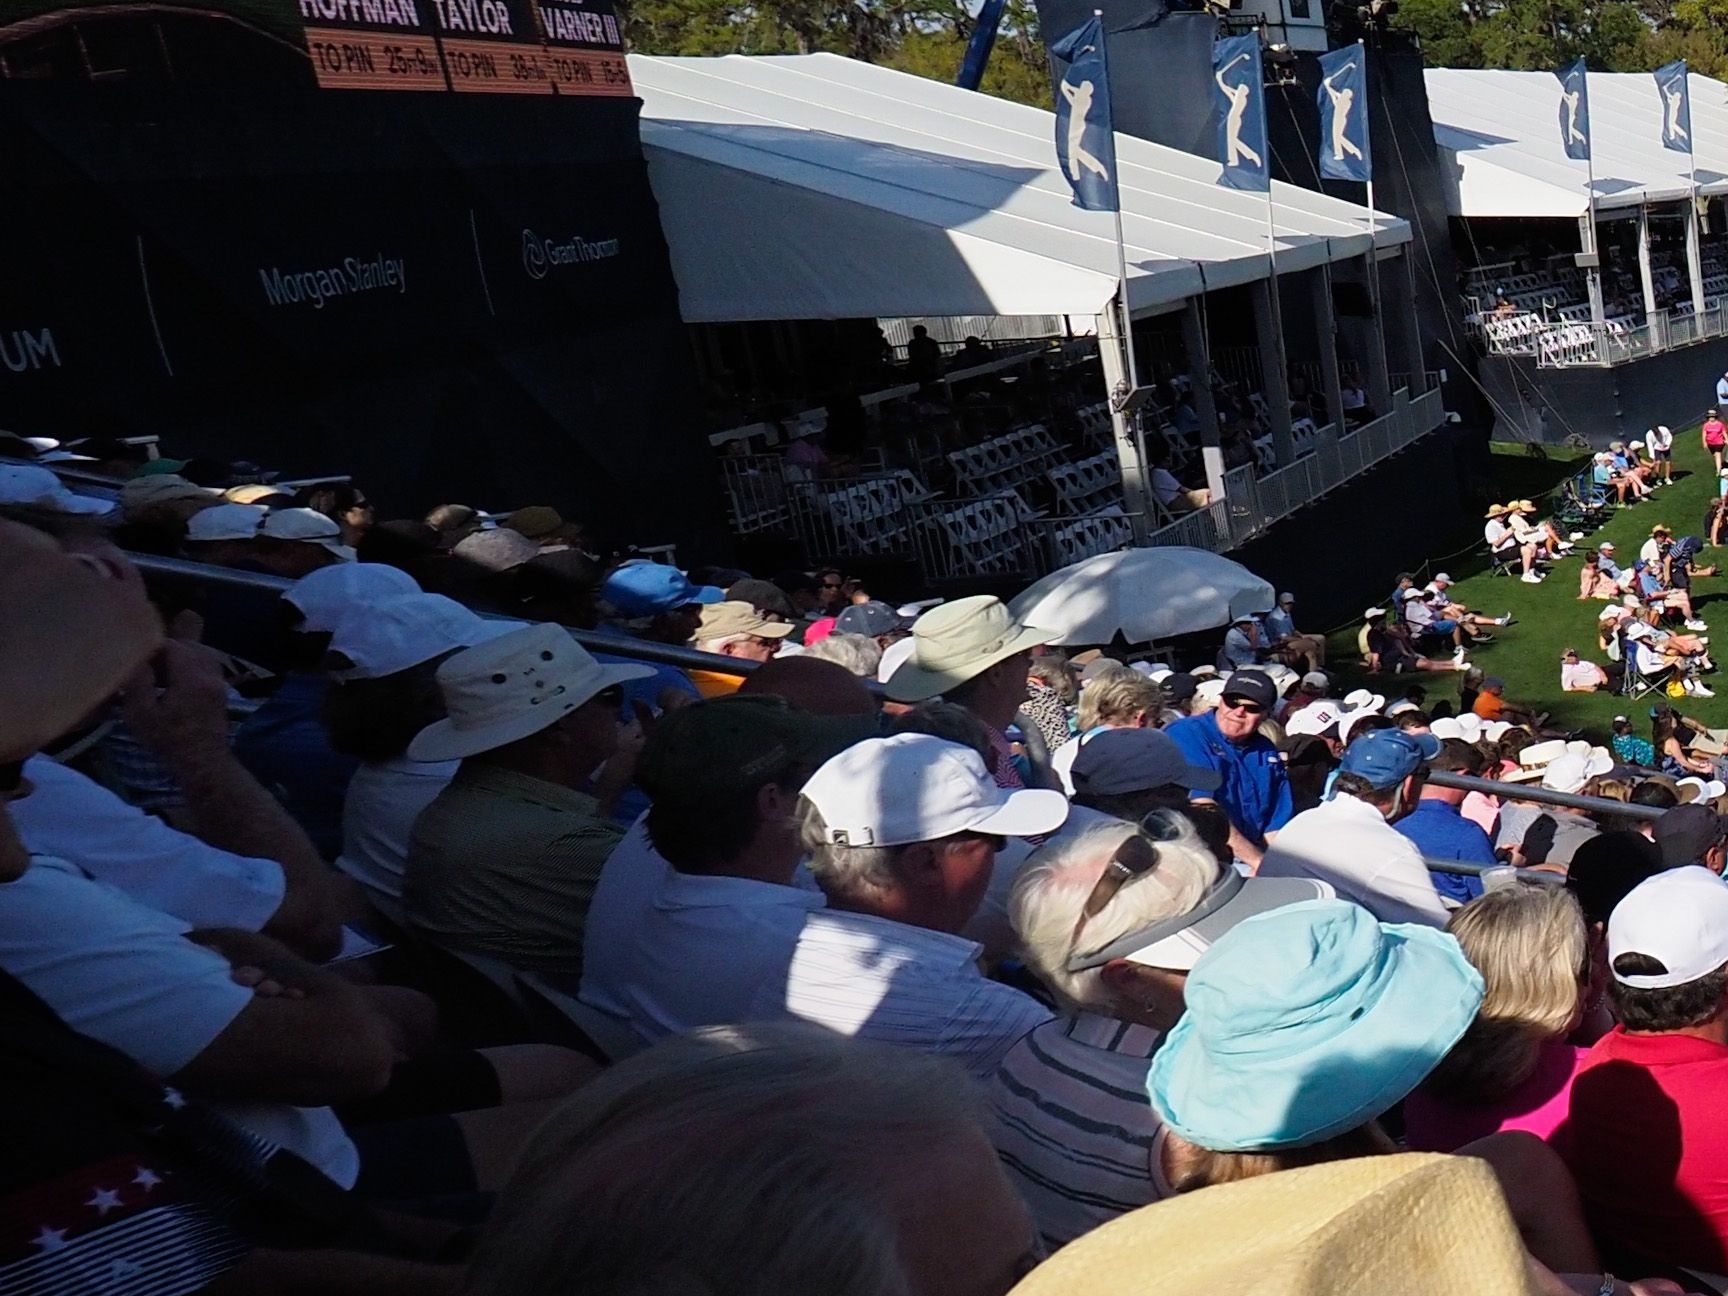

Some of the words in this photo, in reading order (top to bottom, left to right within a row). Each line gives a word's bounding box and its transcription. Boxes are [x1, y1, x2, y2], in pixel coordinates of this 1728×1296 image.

[540, 7, 605, 42] VARNER
[604, 15, 620, 45] III
[314, 44, 342, 72] TO
[344, 45, 376, 74] PIN
[450, 54, 472, 77] TO
[473, 56, 498, 78] PIN
[553, 59, 572, 80] TO
[572, 61, 592, 82] PIN
[258, 268, 344, 309] Morgan
[344, 252, 406, 293] Stanley
